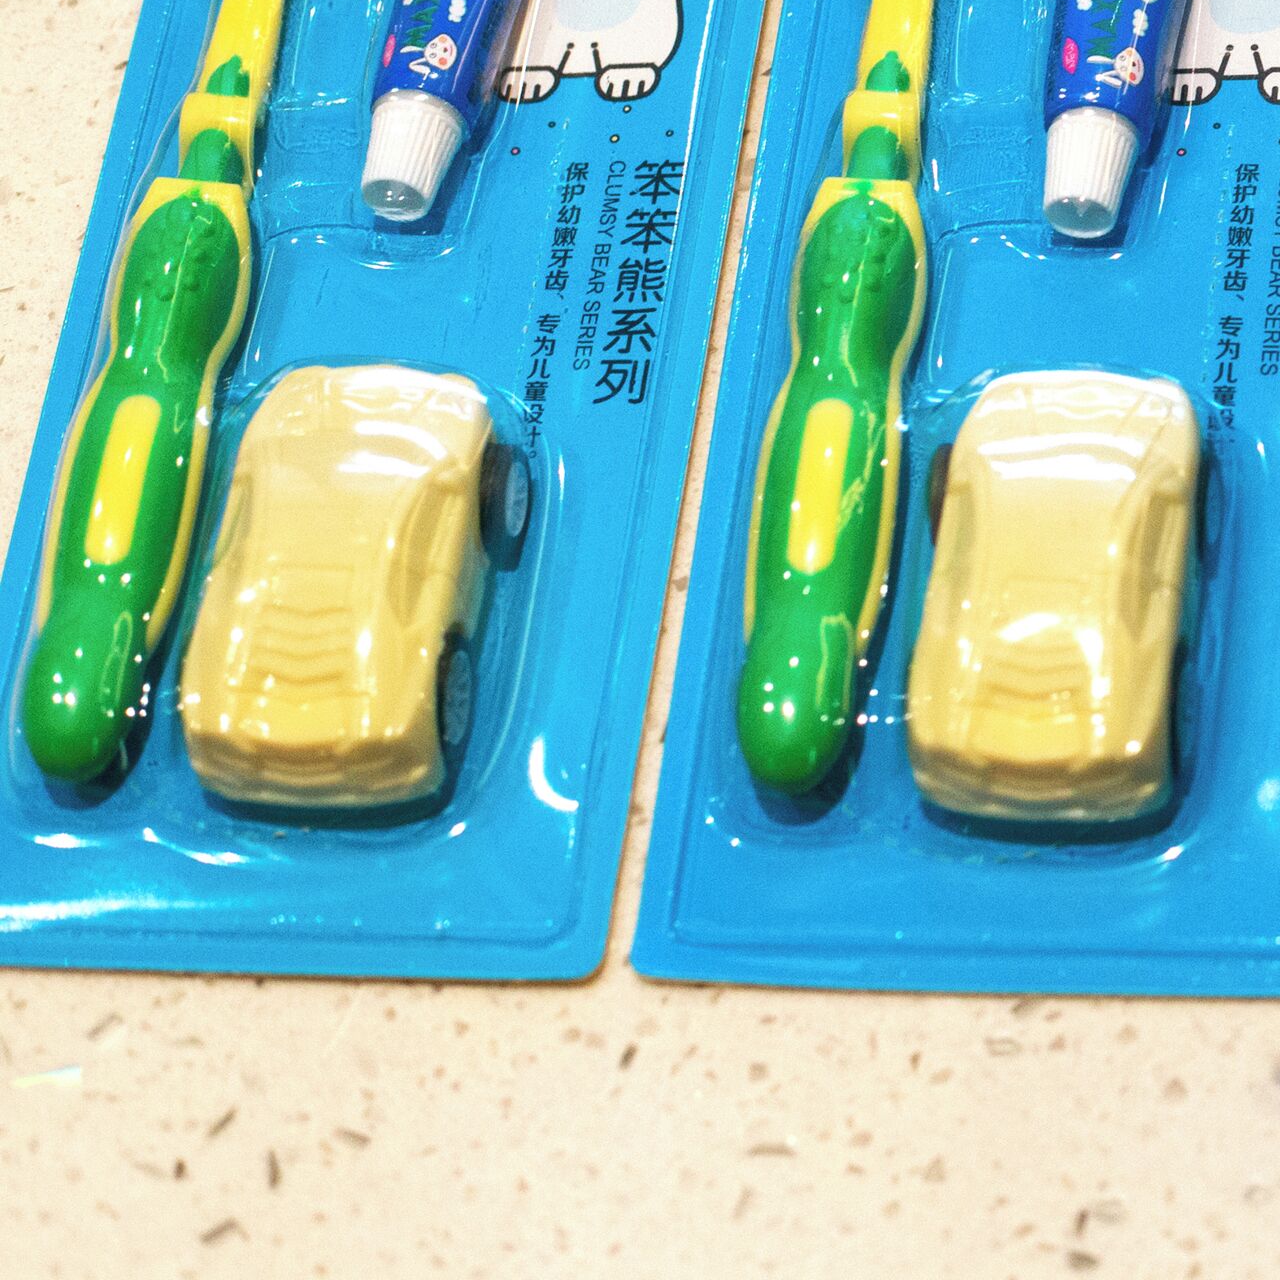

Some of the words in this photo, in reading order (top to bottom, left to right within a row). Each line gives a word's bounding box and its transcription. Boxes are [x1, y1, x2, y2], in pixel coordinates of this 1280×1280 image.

[596, 160, 626, 238] CLUMSY
[586, 243, 612, 294] BEAR
[592, 160, 685, 405] 笨笨熊系列
[572, 301, 601, 370] SERIES
